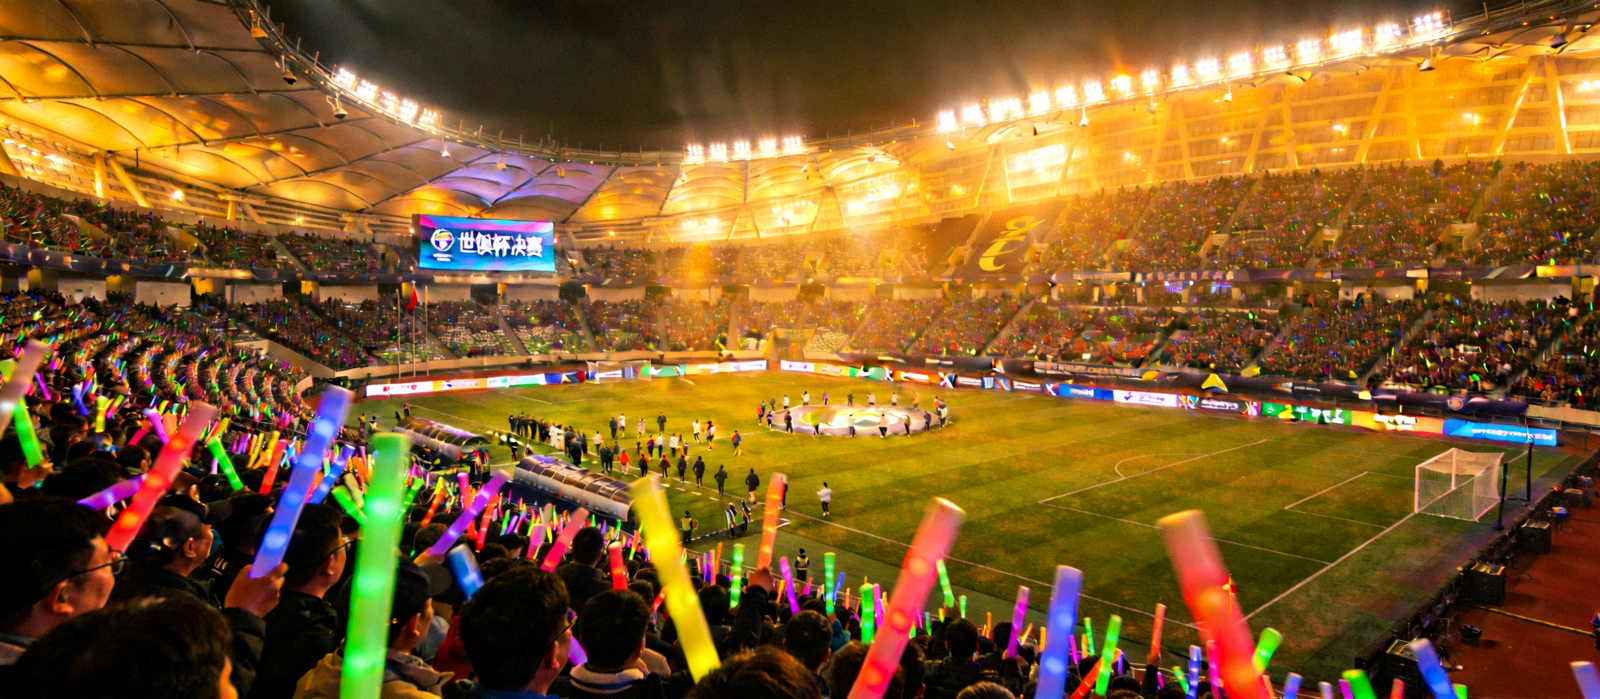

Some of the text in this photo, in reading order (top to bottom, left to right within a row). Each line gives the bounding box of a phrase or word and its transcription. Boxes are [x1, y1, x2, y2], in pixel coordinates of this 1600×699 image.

[458, 230, 543, 258] 世俱杯决赛
